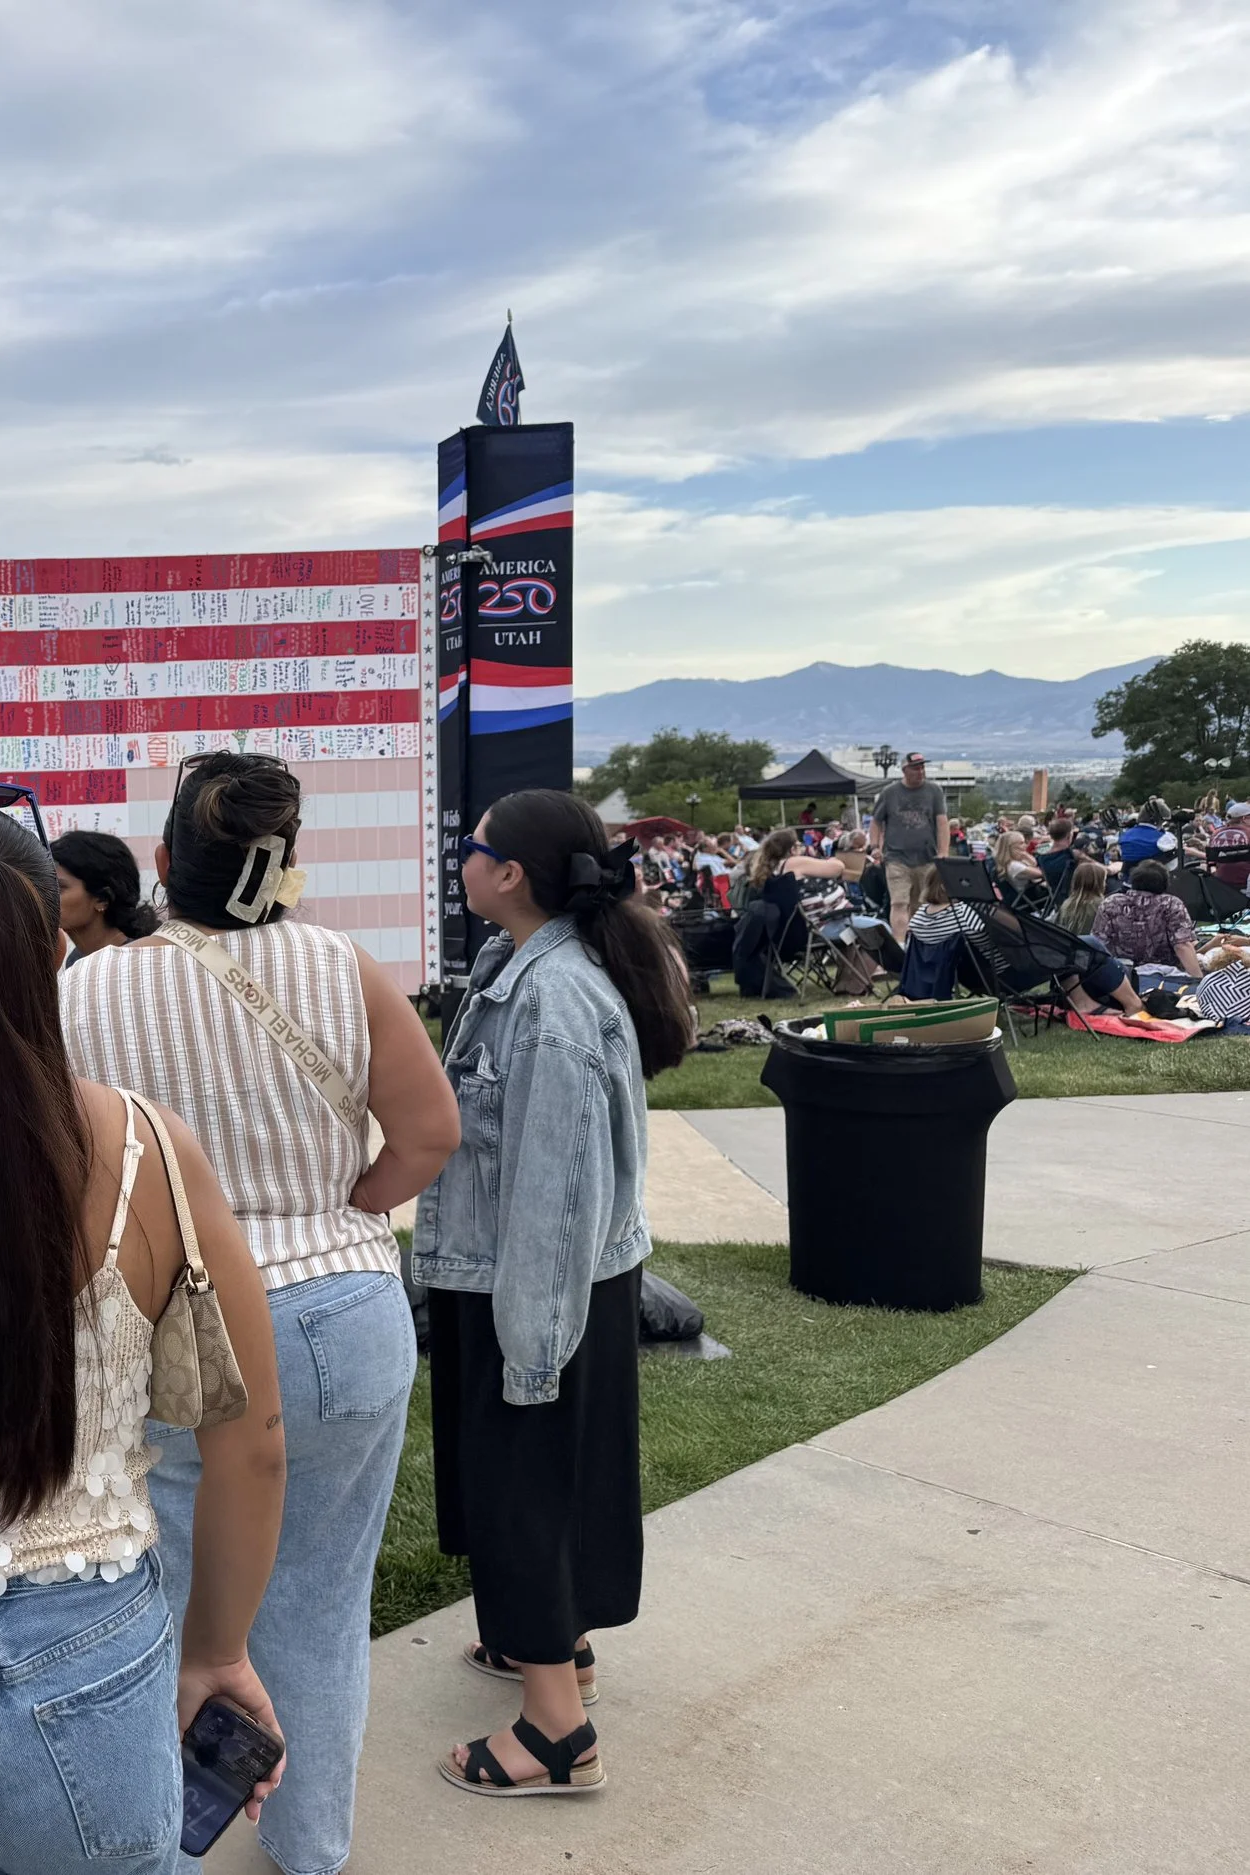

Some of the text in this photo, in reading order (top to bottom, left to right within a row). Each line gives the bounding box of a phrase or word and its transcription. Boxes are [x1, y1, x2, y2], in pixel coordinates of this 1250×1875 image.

[479, 559, 556, 576] AMERICA
[358, 586, 375, 618] LOVE
[478, 577, 557, 618] 250
[494, 630, 541, 646] UTAH
[224, 967, 332, 1085] MICHAEL KORS
